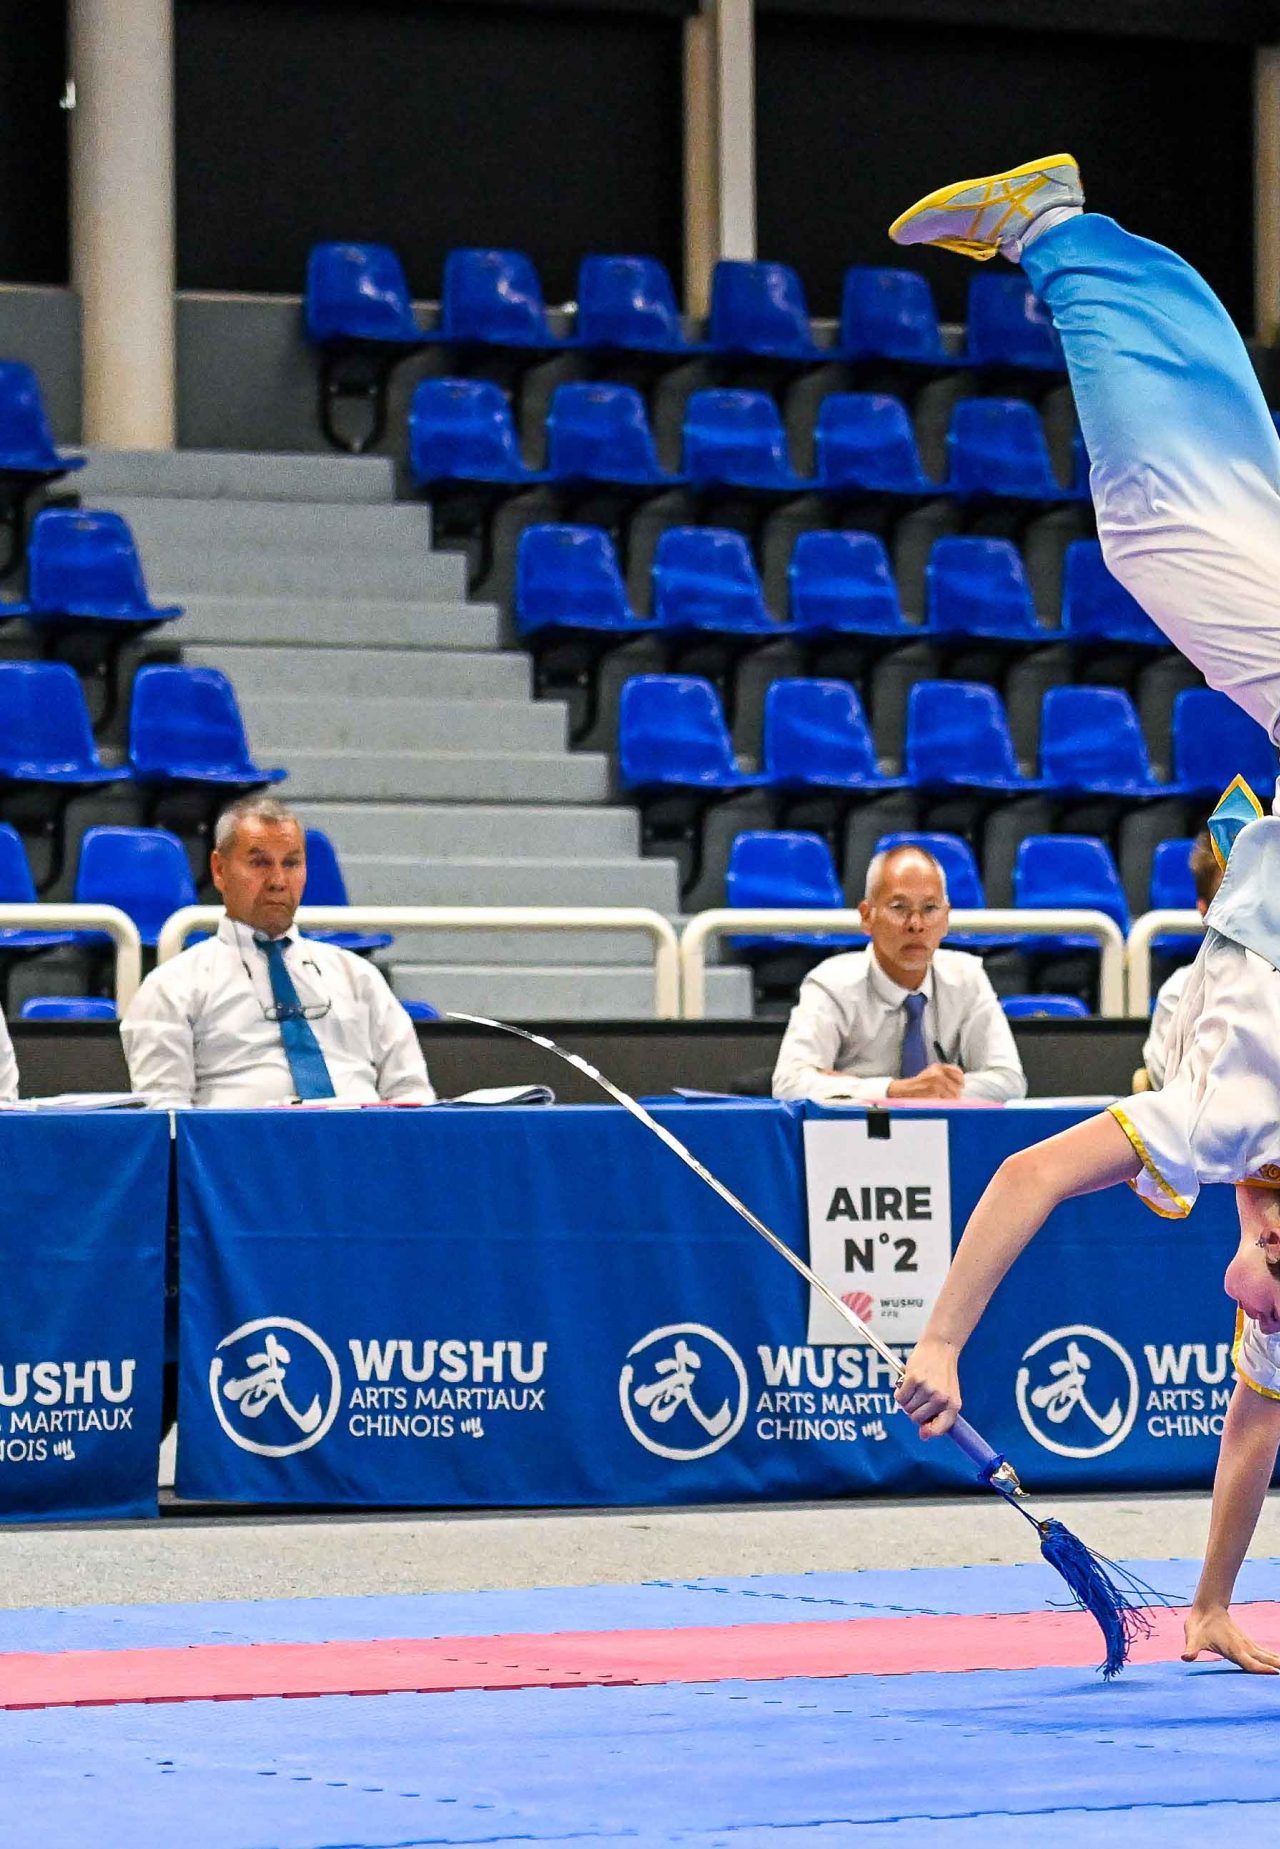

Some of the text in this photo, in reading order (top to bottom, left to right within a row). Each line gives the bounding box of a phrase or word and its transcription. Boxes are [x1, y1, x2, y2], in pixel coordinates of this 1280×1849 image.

[826, 1187, 932, 1222] AIRE
[844, 1232, 918, 1273] N°2
[880, 1299, 924, 1308] WUSHU
[348, 1339, 549, 1384] WUSHU
[757, 1344, 914, 1389] WUSH
[0, 1359, 136, 1407] USHU
[348, 1386, 546, 1412] ARTS MARTIAUX
[756, 1390, 816, 1415] ARTS
[1146, 1388, 1204, 1412] ARTS
[9, 1407, 134, 1434] MARTIAUX
[348, 1414, 455, 1438] CHINOIS
[756, 1416, 858, 1442] CHINOIS
[1147, 1413, 1227, 1437] CHINO
